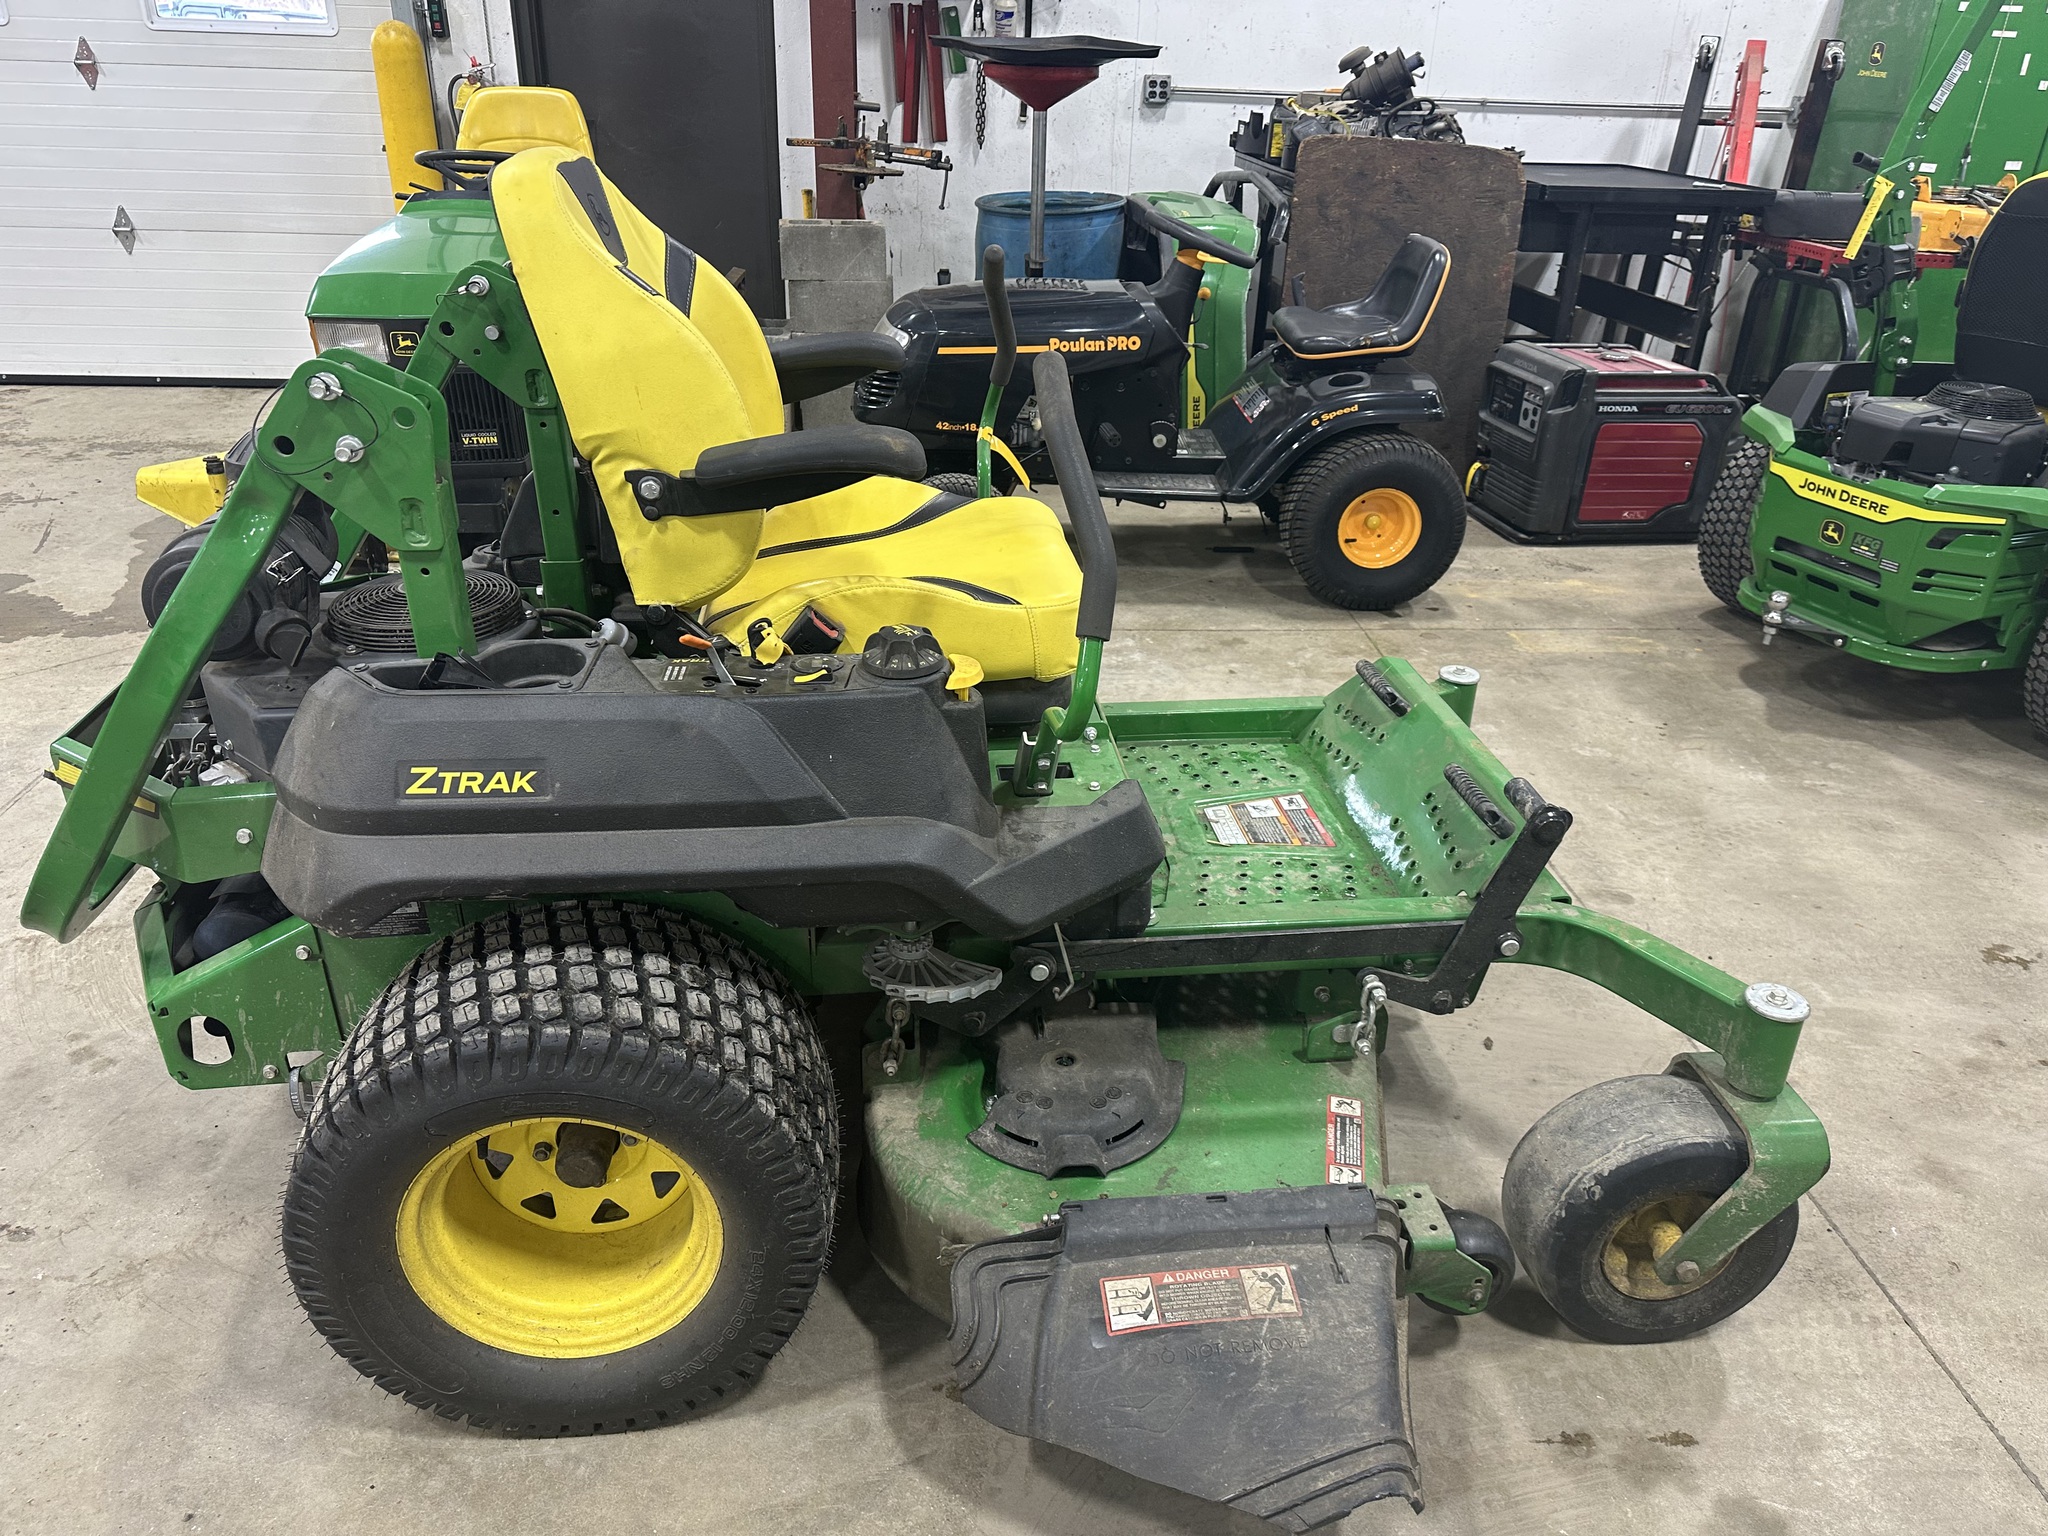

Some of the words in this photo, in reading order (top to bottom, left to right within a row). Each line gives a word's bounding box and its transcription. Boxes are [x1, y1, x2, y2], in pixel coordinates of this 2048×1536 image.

[1049, 336, 1106, 352] Poulan
[1107, 335, 1141, 351] PRO
[1513, 358, 1538, 373] HONDA
[1192, 396, 1201, 428] EERE
[1311, 418, 1320, 427] 6
[1321, 404, 1359, 421] Speed
[1597, 405, 1639, 413] HONDA
[462, 436, 498, 445] V-TWIN
[1798, 478, 1837, 499] JOHN
[1838, 489, 1890, 516] DEERE
[1853, 534, 1882, 550] KFG
[405, 766, 538, 795] ZTRAK
[1175, 1268, 1231, 1282] DANGER
[1148, 1350, 1176, 1367] DO
[1185, 1342, 1222, 1361] NOT
[1231, 1336, 1309, 1358] REMOVE
